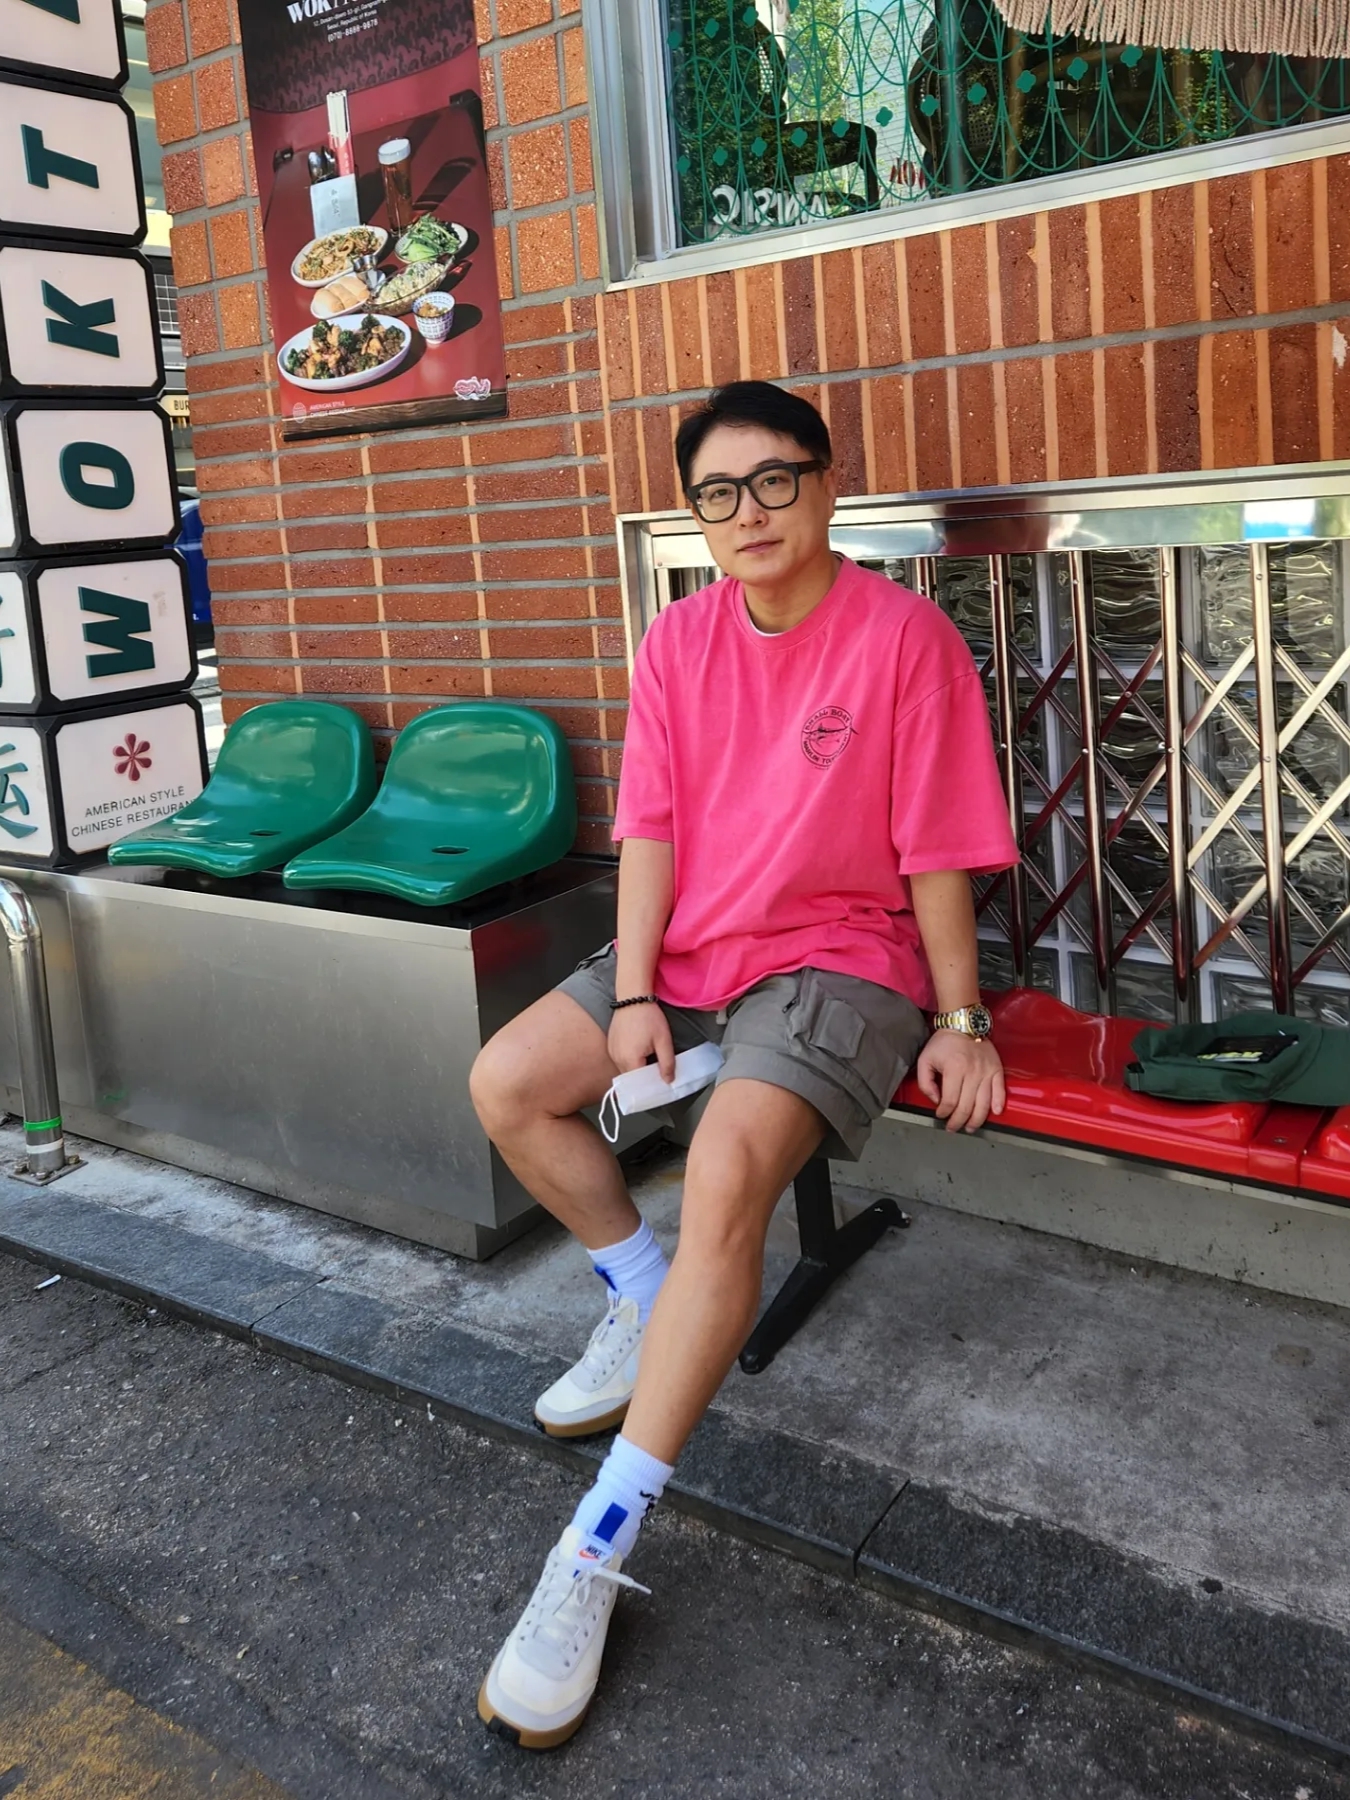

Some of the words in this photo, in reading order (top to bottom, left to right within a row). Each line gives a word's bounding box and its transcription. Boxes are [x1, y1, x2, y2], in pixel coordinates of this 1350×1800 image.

[340, 15, 358, 25] Republic
[364, 9, 377, 17] Korea
[831, 708, 850, 723] BOAT
[85, 795, 146, 818] AMERICAN
[150, 785, 185, 803] STYLE
[71, 815, 123, 837] CHINESE
[586, 1544, 602, 1558] NIKE
